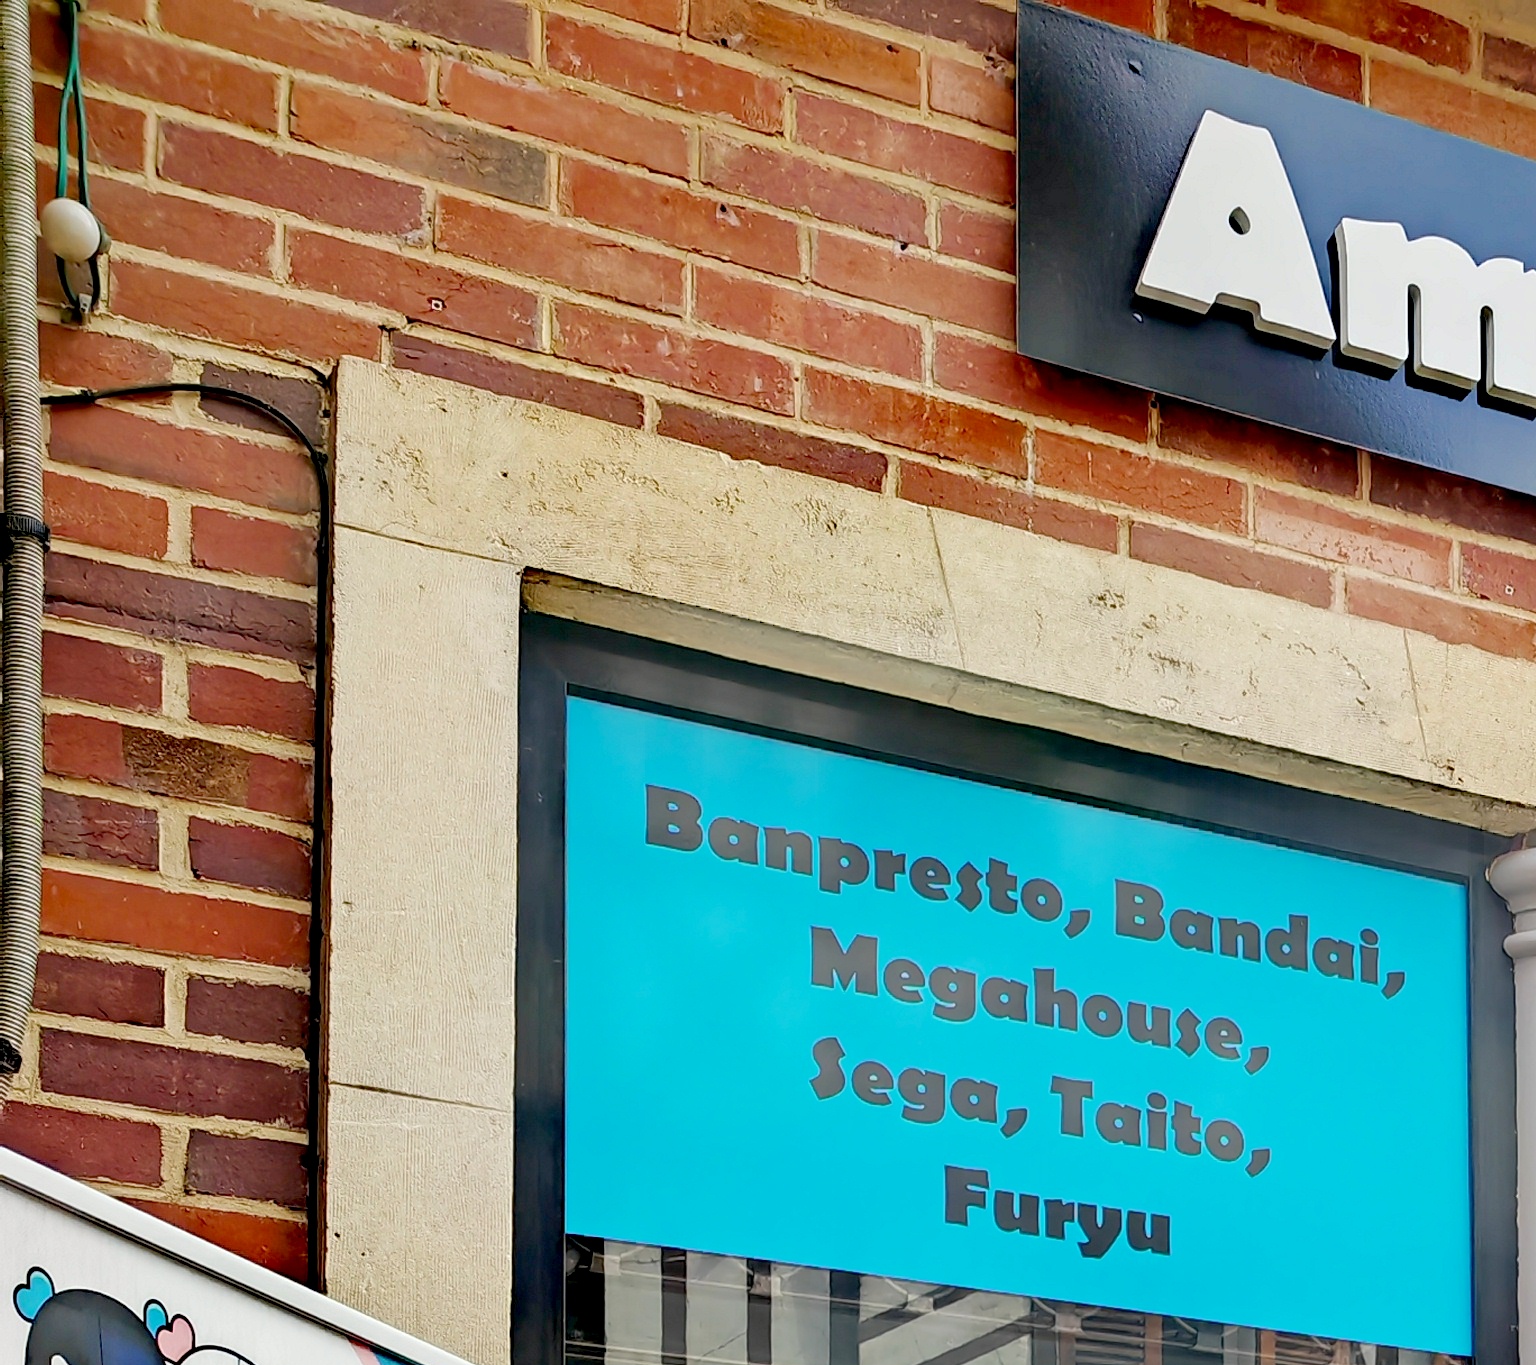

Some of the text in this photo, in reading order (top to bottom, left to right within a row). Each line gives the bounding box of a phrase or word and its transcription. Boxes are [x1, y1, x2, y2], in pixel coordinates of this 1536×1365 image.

[645, 783, 1406, 1000] Banpresto, Bandai,
[809, 926, 1269, 1074] Megahouse,
[809, 1036, 1271, 1177] Sega, Taito,
[944, 1164, 1172, 1258] Furyu
